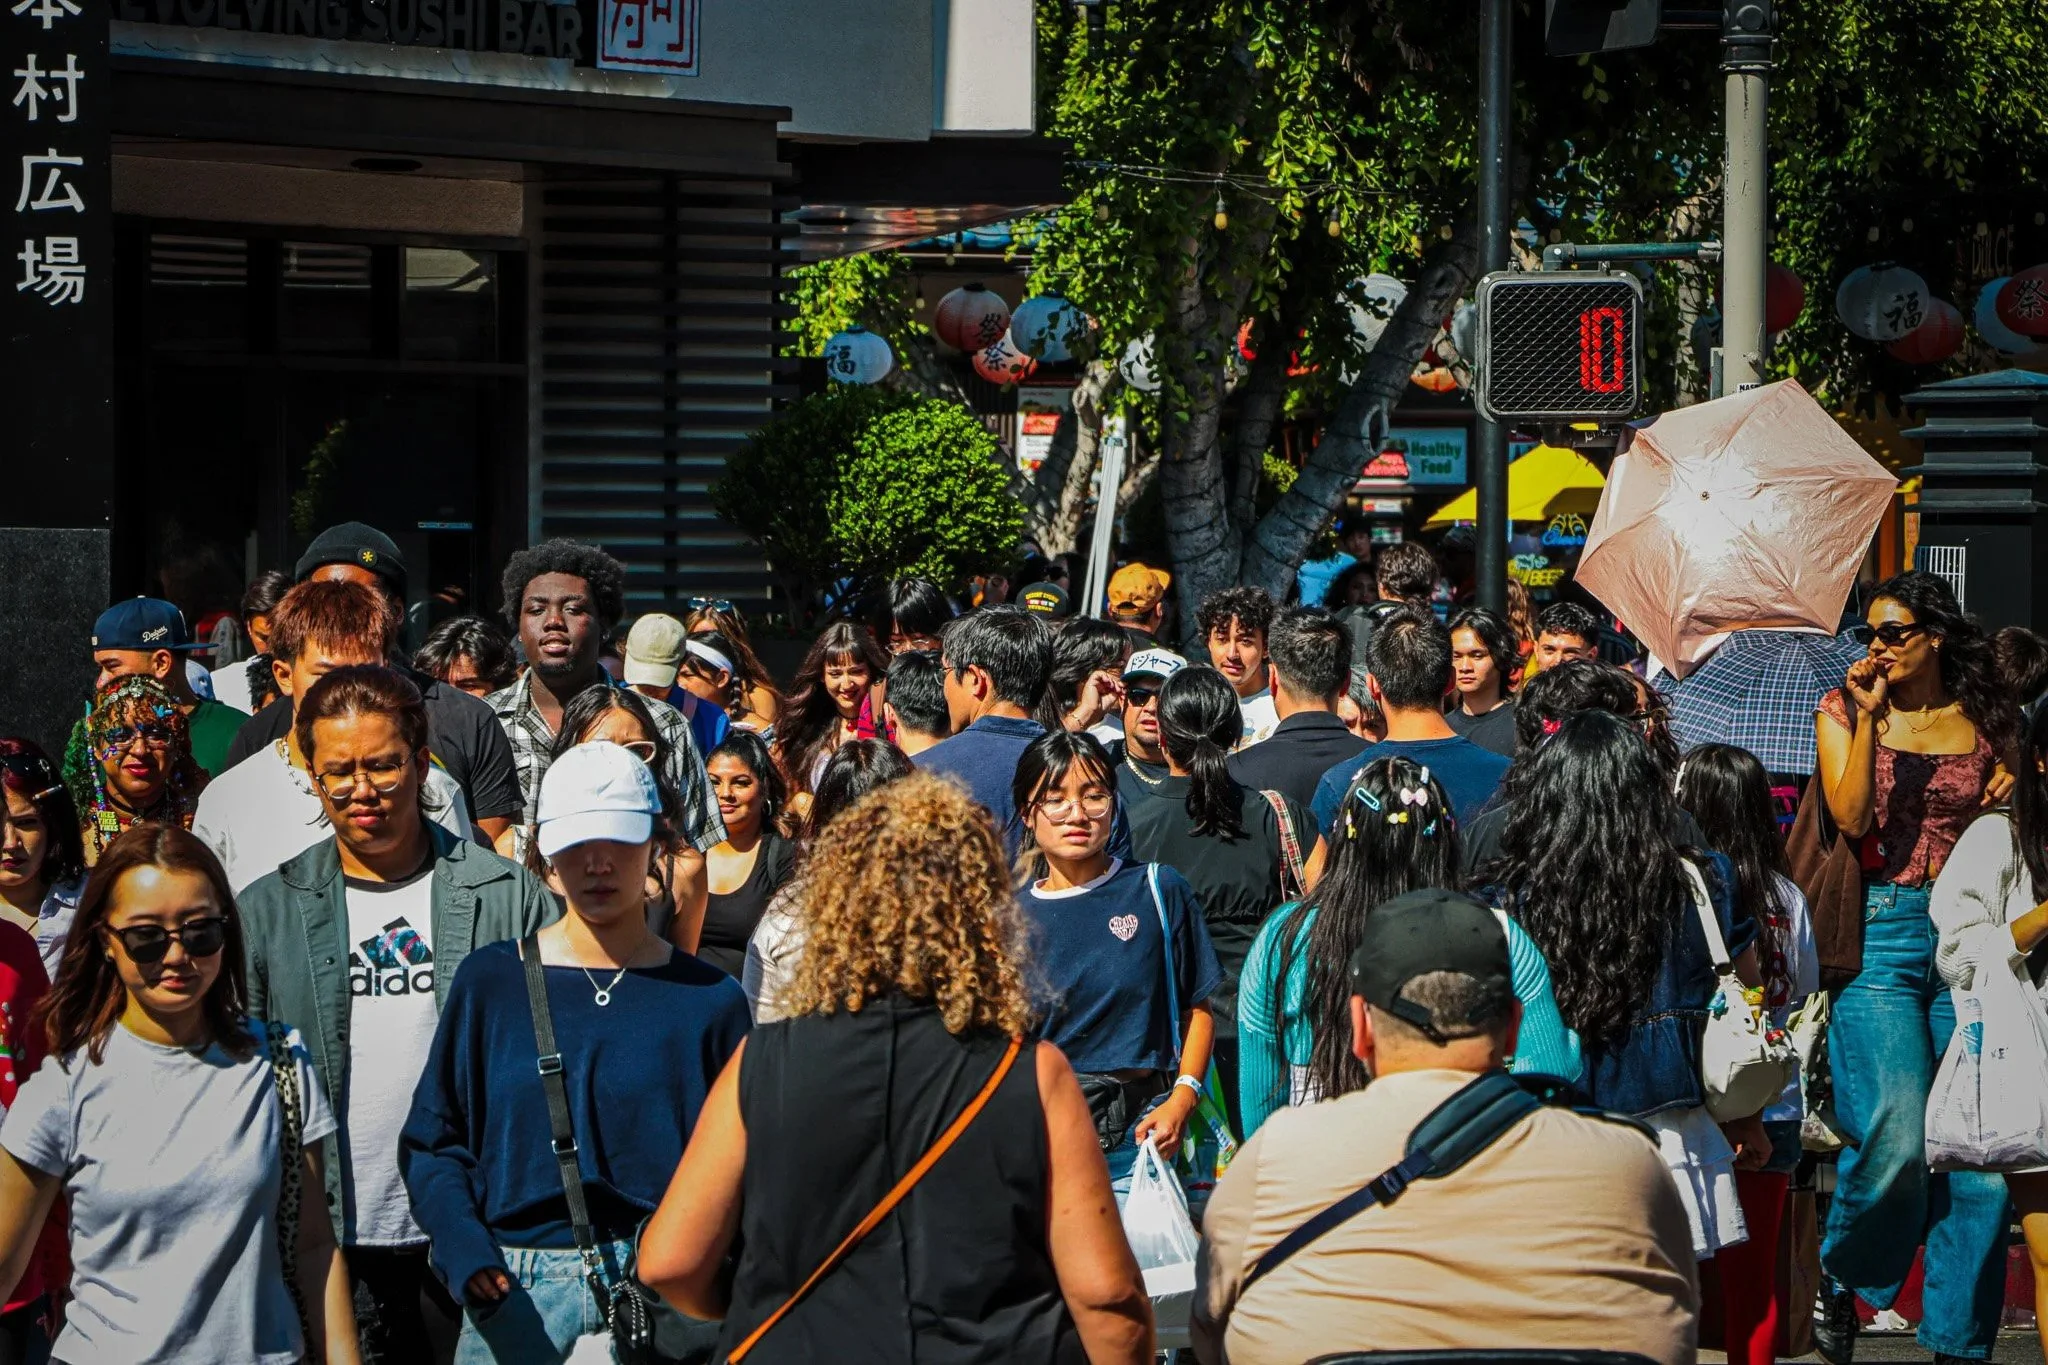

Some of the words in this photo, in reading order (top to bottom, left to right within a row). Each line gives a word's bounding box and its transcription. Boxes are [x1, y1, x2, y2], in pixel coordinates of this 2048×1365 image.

[360, 0, 487, 52] SUSHI
[499, 0, 584, 60] BAR
[1883, 291, 1923, 332] 福
[1411, 441, 1462, 460] Healthy
[1421, 459, 1452, 474] Food
[142, 625, 168, 643] Dodgers
[351, 967, 435, 996] dida
